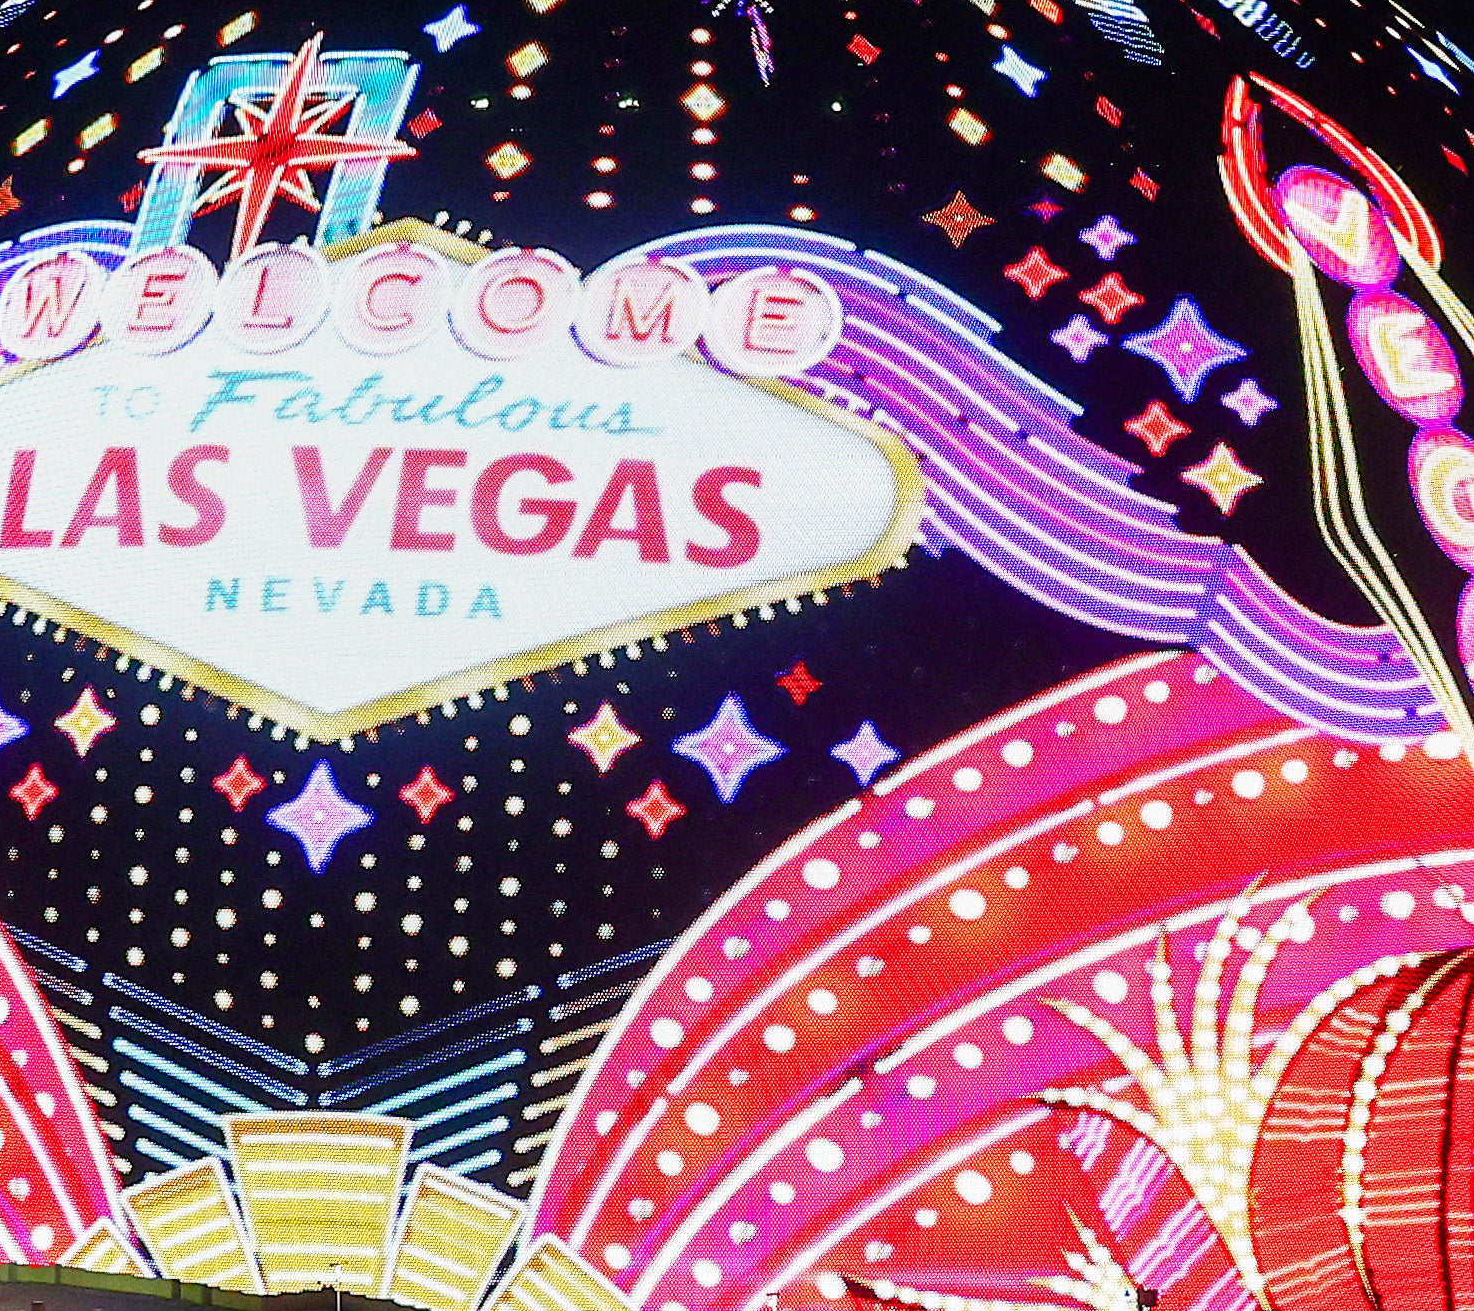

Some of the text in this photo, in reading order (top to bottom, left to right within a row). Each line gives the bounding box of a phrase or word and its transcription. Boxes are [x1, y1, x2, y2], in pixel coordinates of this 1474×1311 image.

[16, 250, 812, 358] WELCOME
[92, 368, 664, 438] TO Fabulous
[291, 445, 765, 569] VEGAS
[205, 576, 504, 621] NEVADA
